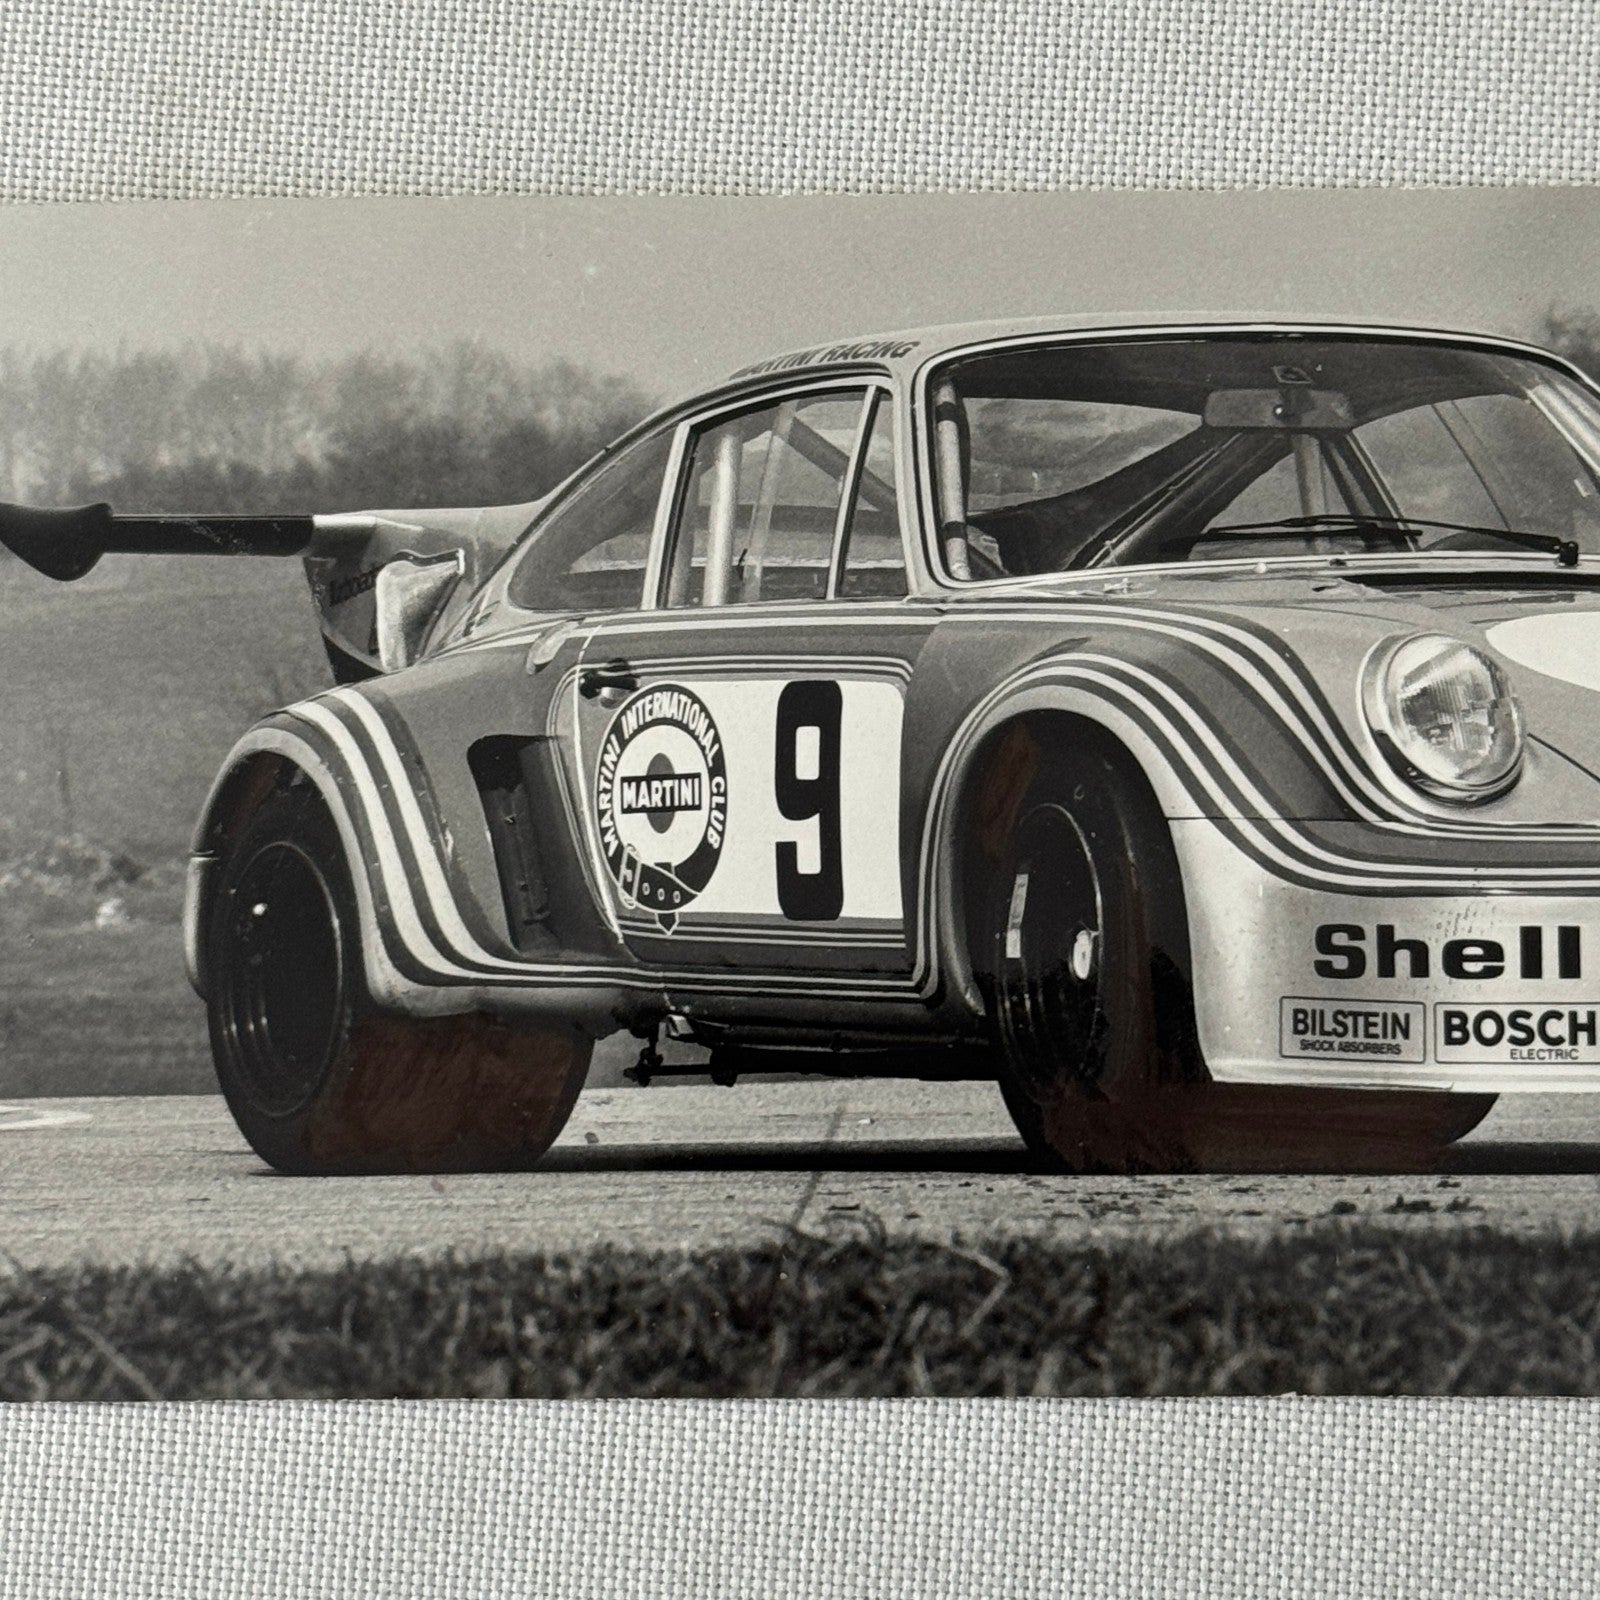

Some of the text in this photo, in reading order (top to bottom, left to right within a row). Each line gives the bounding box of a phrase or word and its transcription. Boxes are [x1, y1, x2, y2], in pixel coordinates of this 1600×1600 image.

[818, 340, 921, 363] RACING
[598, 691, 726, 857] MARTINI INTERNATIONAL CLUB
[622, 777, 701, 809] MARTINI
[775, 680, 844, 921] 9
[1314, 923, 1582, 980] Shell
[1292, 1008, 1411, 1040] BILSTEIN
[1443, 1010, 1598, 1047] BOSCH
[1299, 1039, 1402, 1054] SHOCK ABSORBERS
[1510, 1048, 1580, 1061] ELECTRIC
